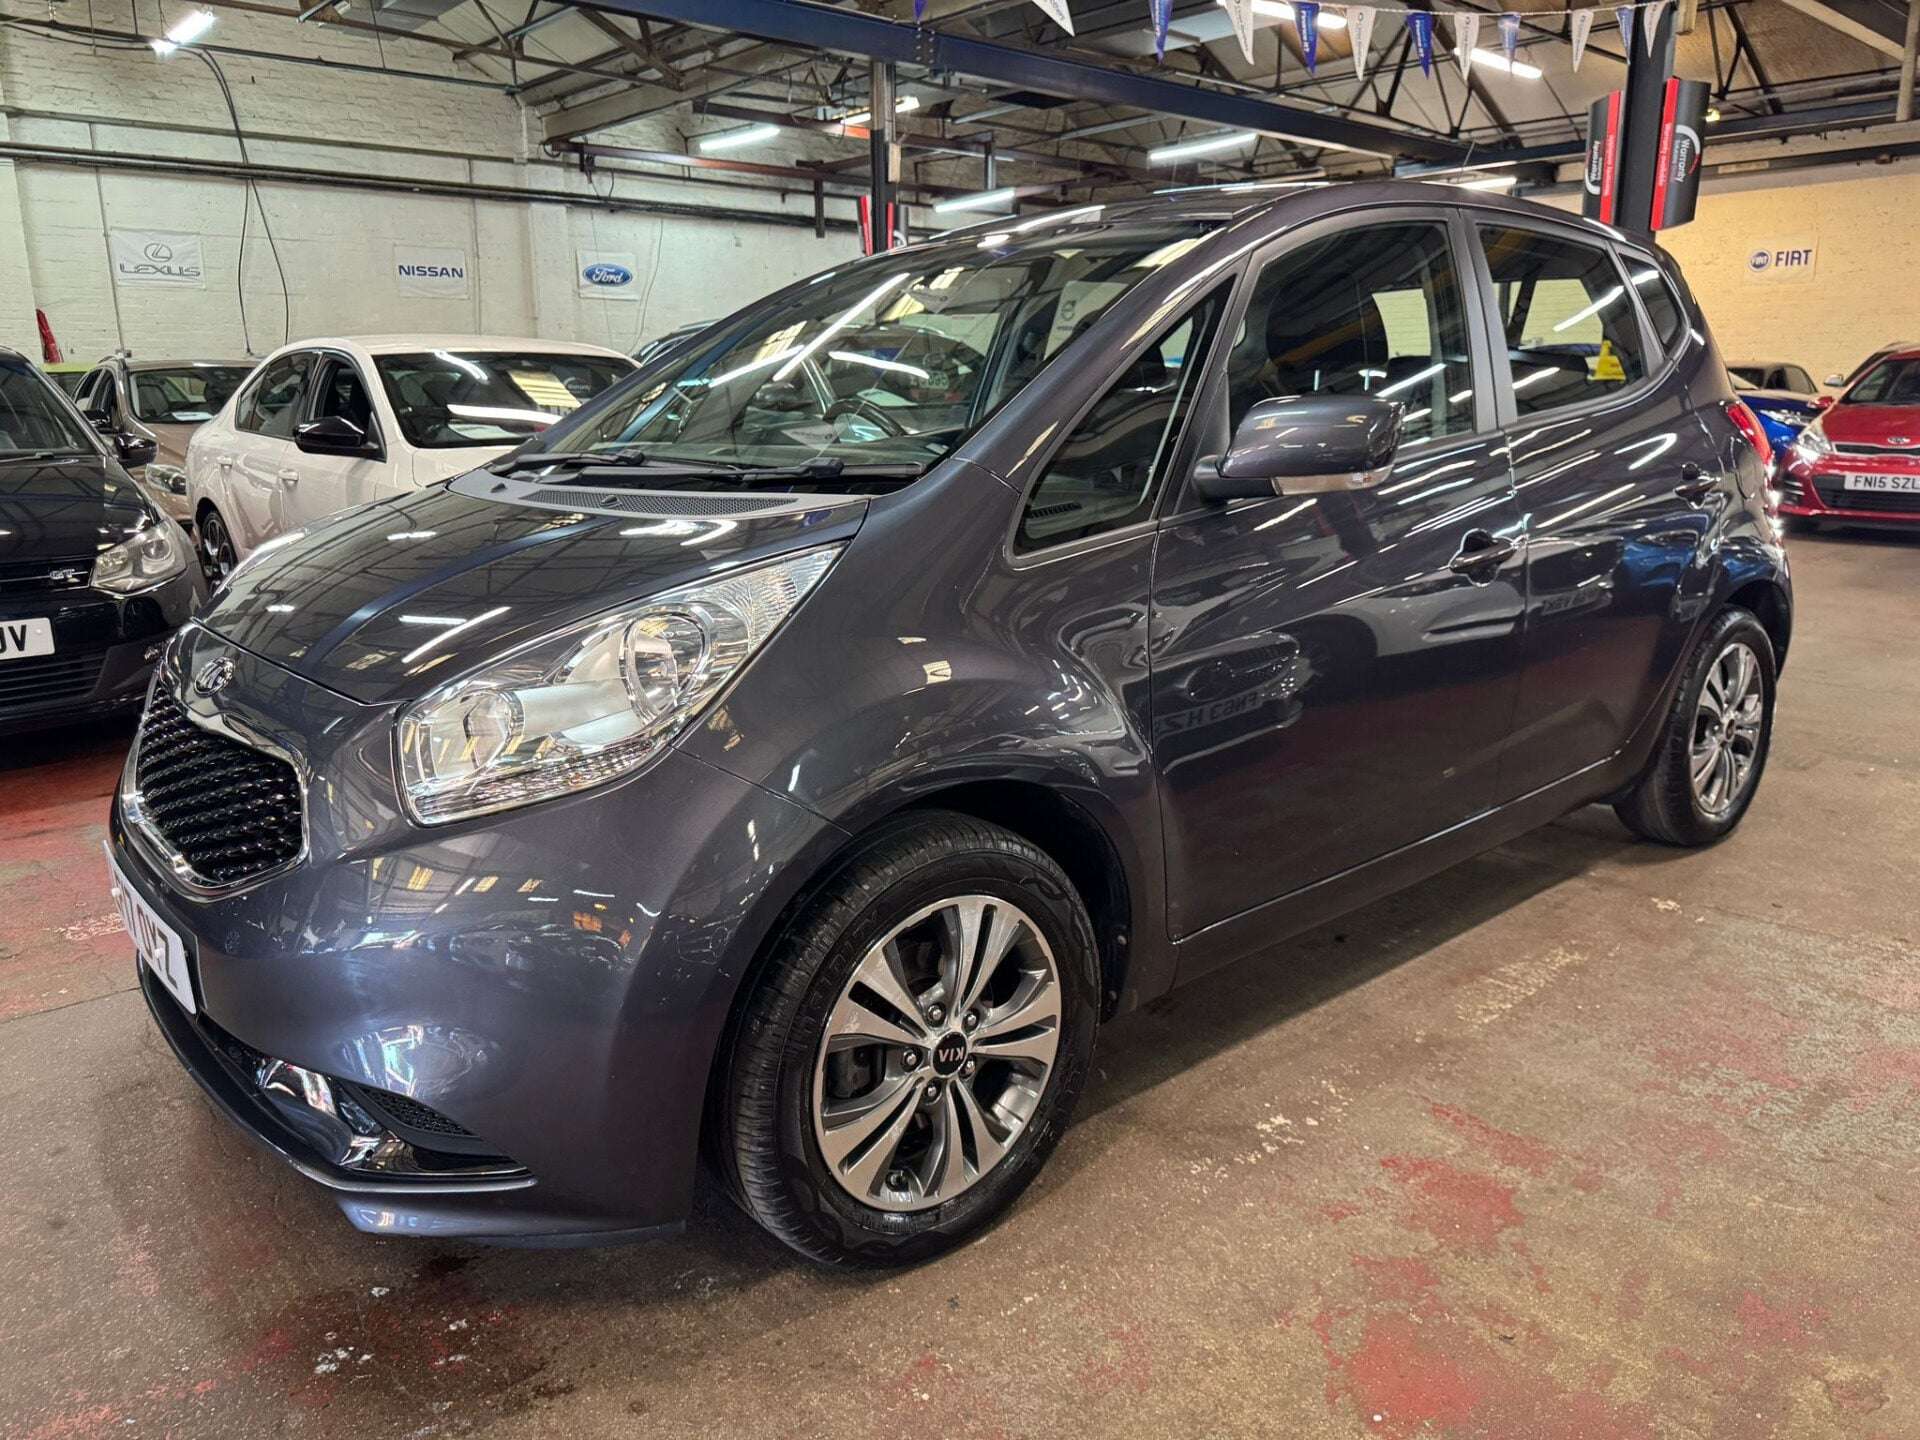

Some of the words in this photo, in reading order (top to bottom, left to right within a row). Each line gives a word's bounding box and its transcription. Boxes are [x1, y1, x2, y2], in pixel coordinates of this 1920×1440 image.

[1677, 138, 1691, 182] Warranty
[1775, 249, 1813, 267] FIAT
[119, 263, 201, 277] LEXUS
[398, 264, 464, 279] NISSAN
[591, 267, 625, 284] Ford
[1853, 475, 1886, 489] FN15
[1891, 477, 1920, 490] SZL
[938, 1046, 965, 1063] KIA
